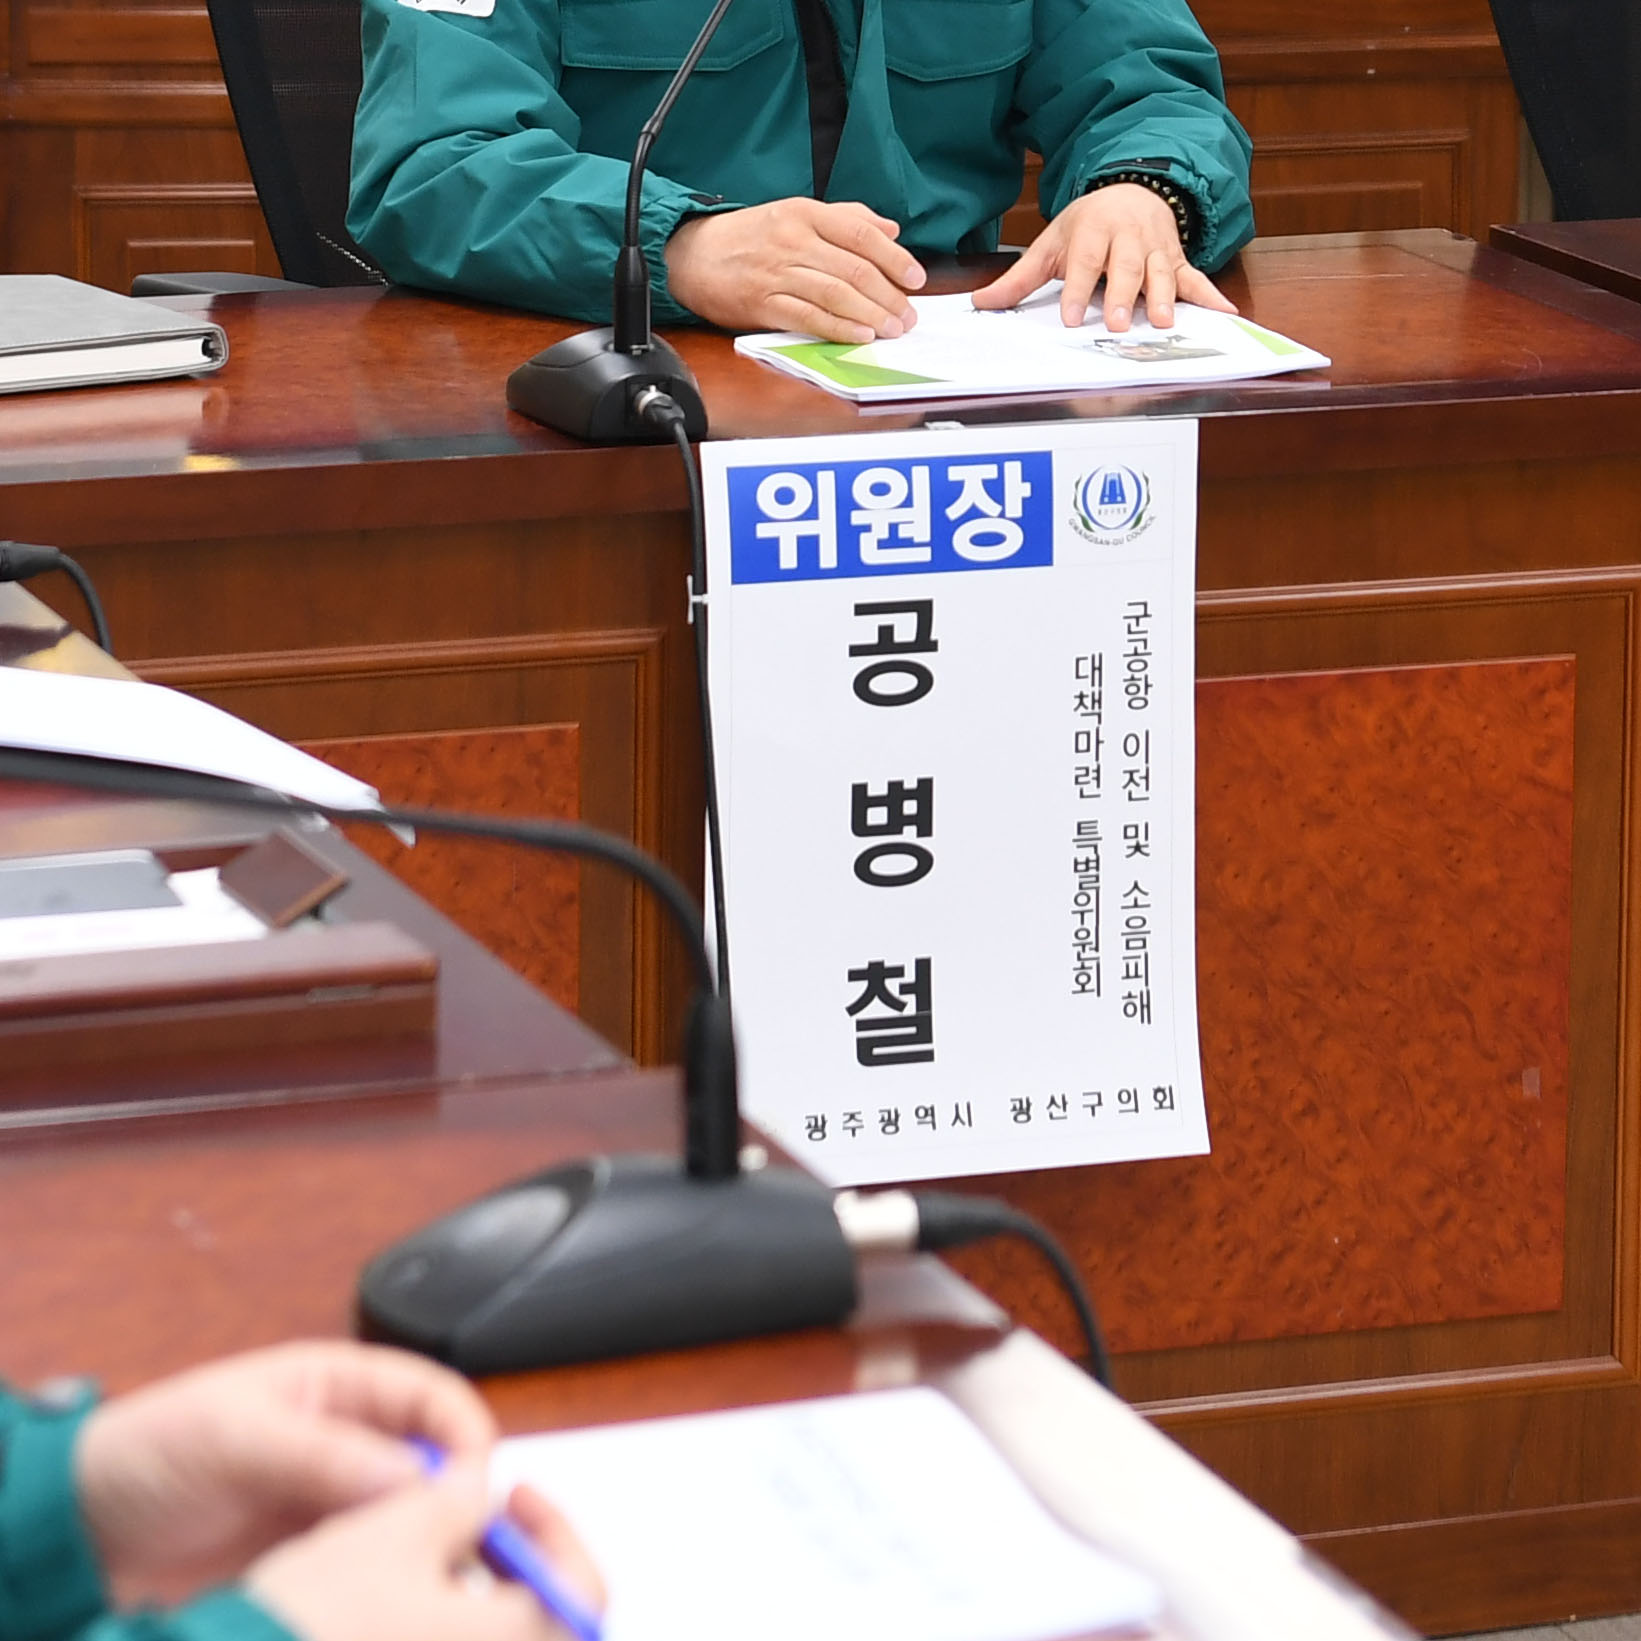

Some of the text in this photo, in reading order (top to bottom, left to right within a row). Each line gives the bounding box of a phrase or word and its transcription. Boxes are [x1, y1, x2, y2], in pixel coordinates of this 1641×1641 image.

[756, 461, 1031, 569] 위원장
[1071, 653, 1104, 997] 대책마련 특별위원회
[1121, 601, 1153, 1024] 군공항 이전 및 소음피해
[805, 1085, 1174, 1141] 광주광역시 광산구의회
